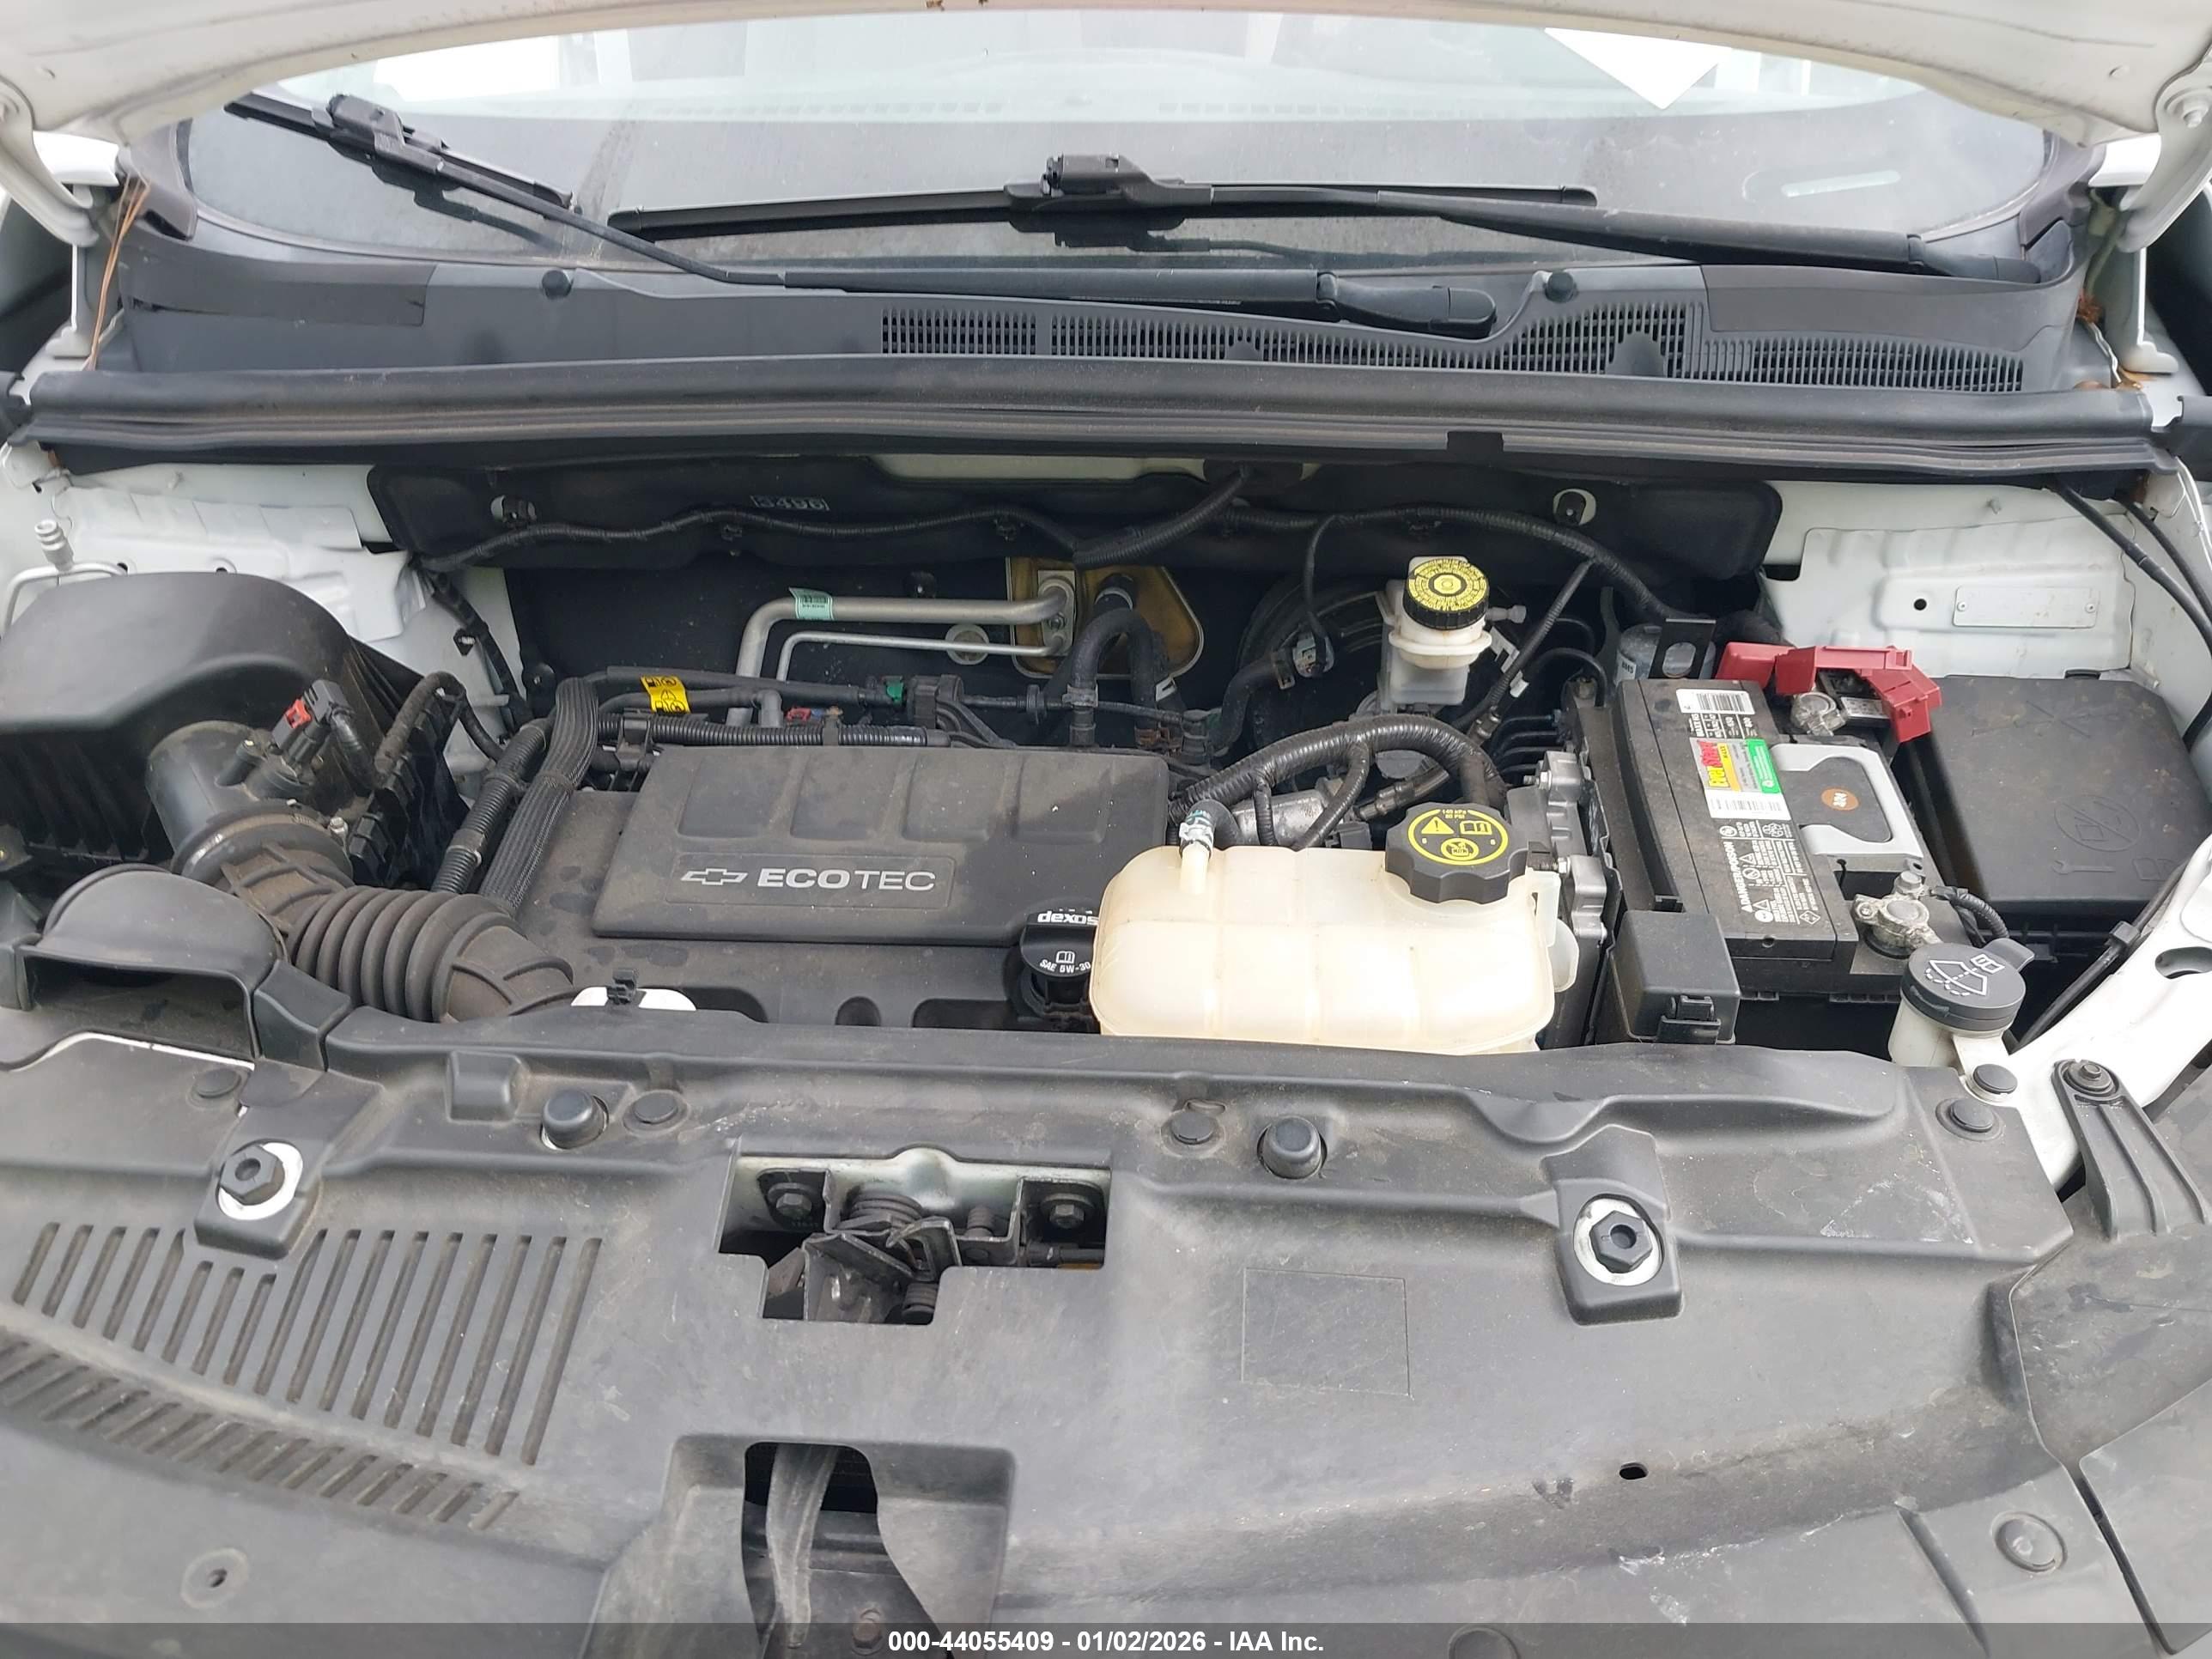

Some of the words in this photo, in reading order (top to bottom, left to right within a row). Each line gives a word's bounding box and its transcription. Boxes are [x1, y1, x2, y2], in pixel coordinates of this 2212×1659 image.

[757, 867, 936, 890] ECOTEC
[1037, 910, 1099, 925] dexos
[1039, 959, 1057, 972] SAE
[1060, 961, 1091, 974] 5W-30
